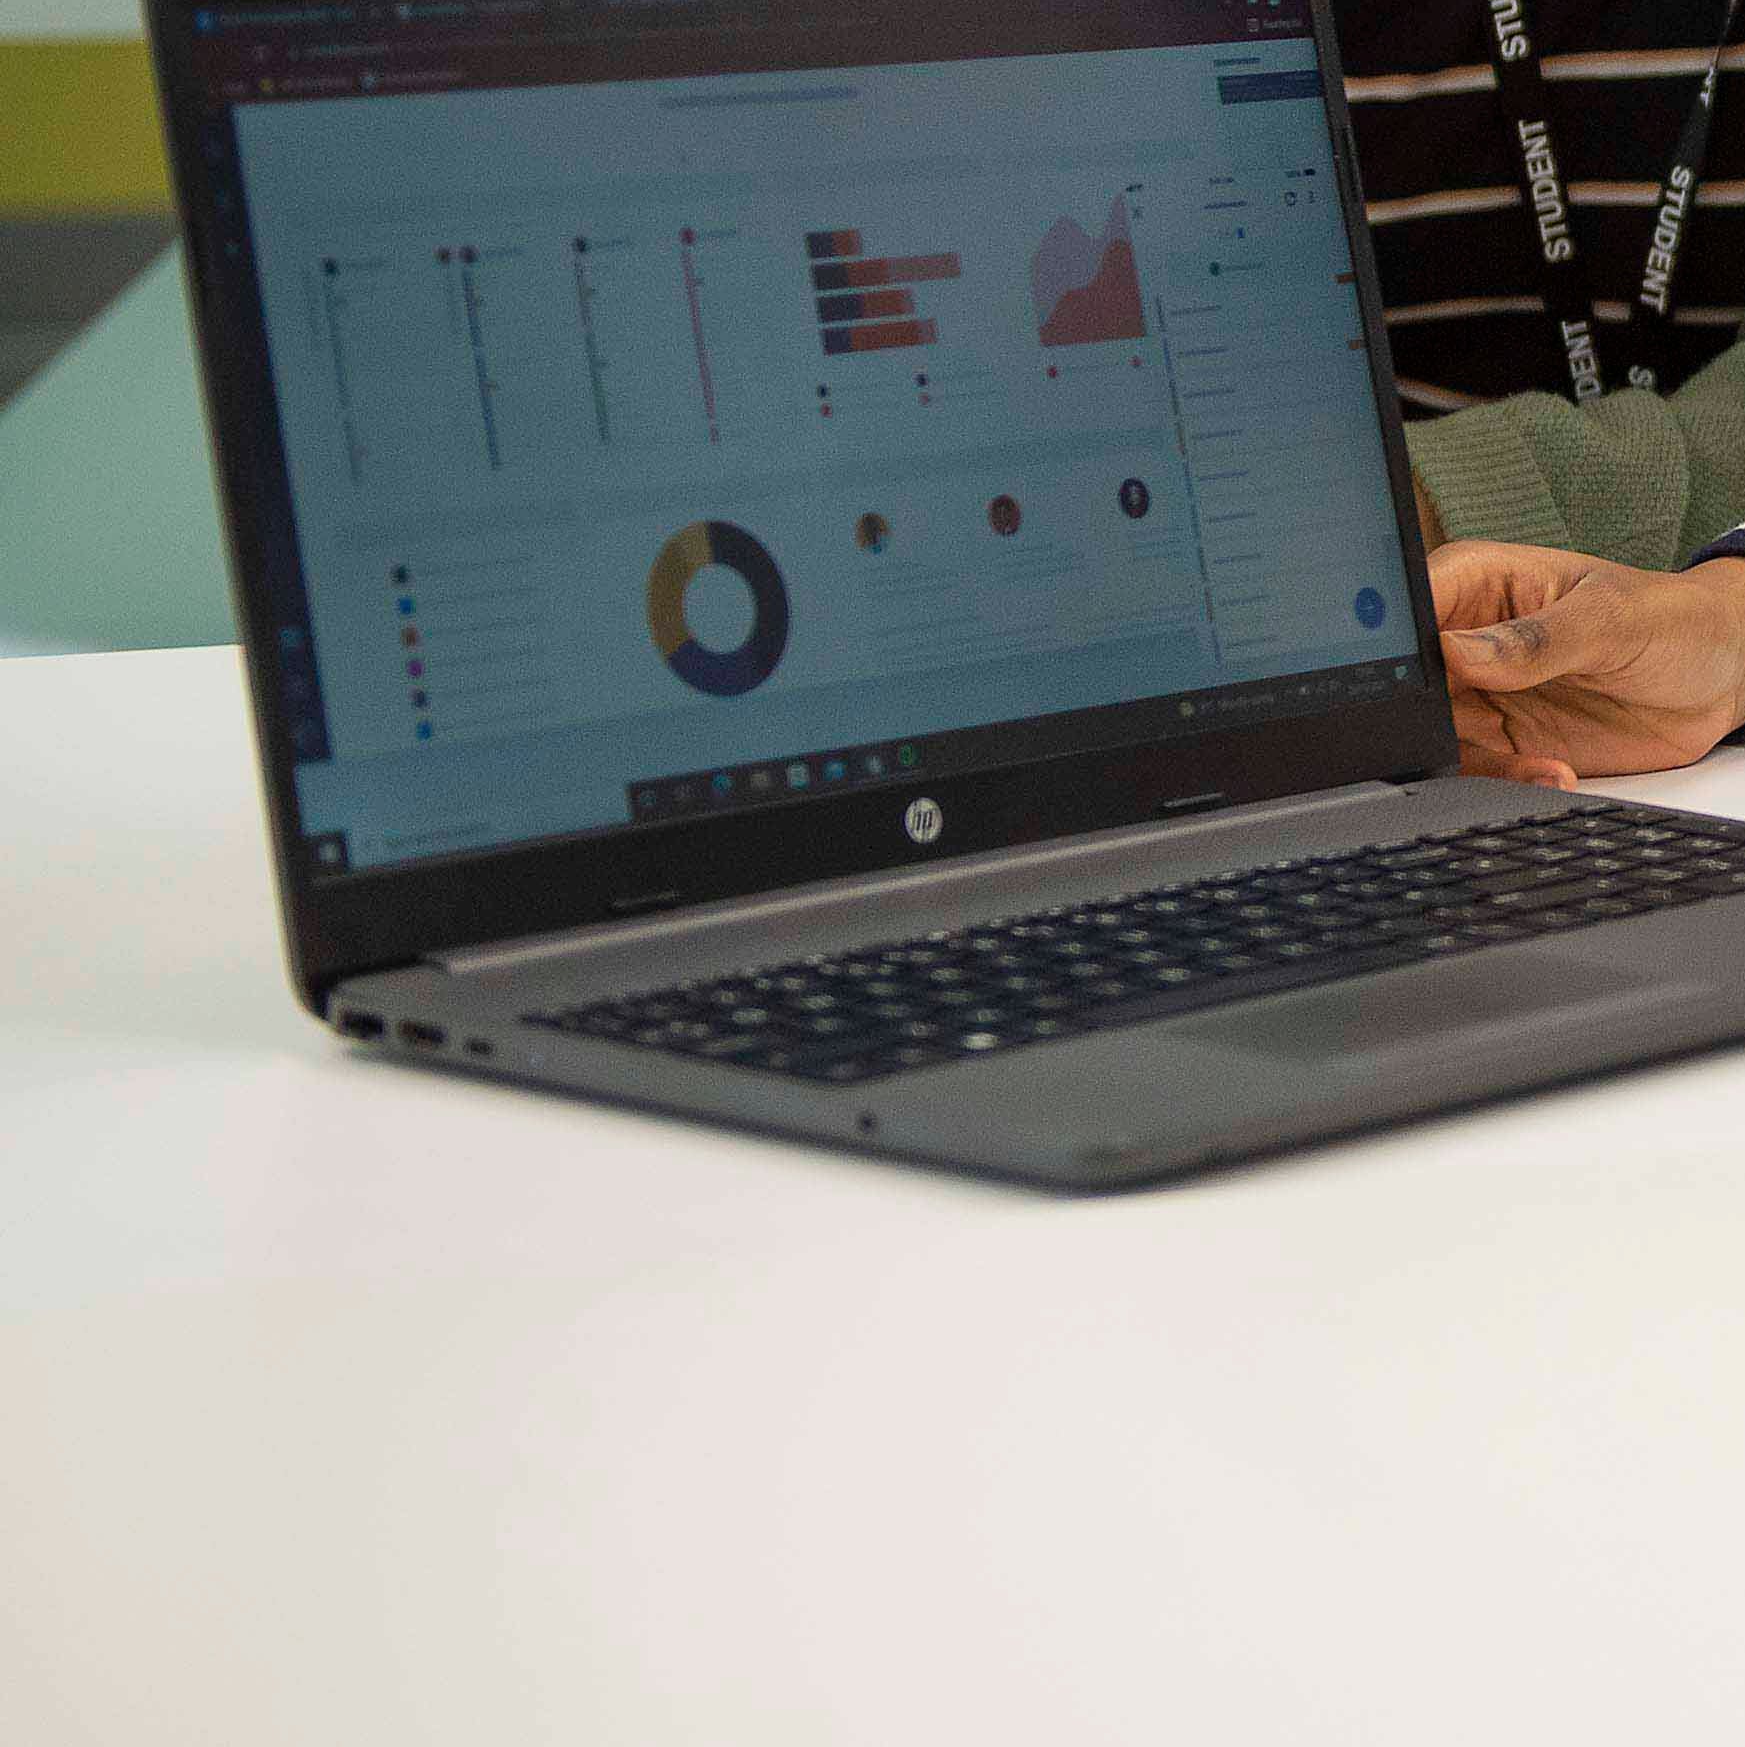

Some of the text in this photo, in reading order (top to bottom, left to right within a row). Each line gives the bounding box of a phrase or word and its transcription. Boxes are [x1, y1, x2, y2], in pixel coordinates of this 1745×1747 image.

[1518, 118, 1573, 261] STUDENT
[1640, 163, 1693, 315] STUDENT
[1562, 320, 1601, 400] DENT
